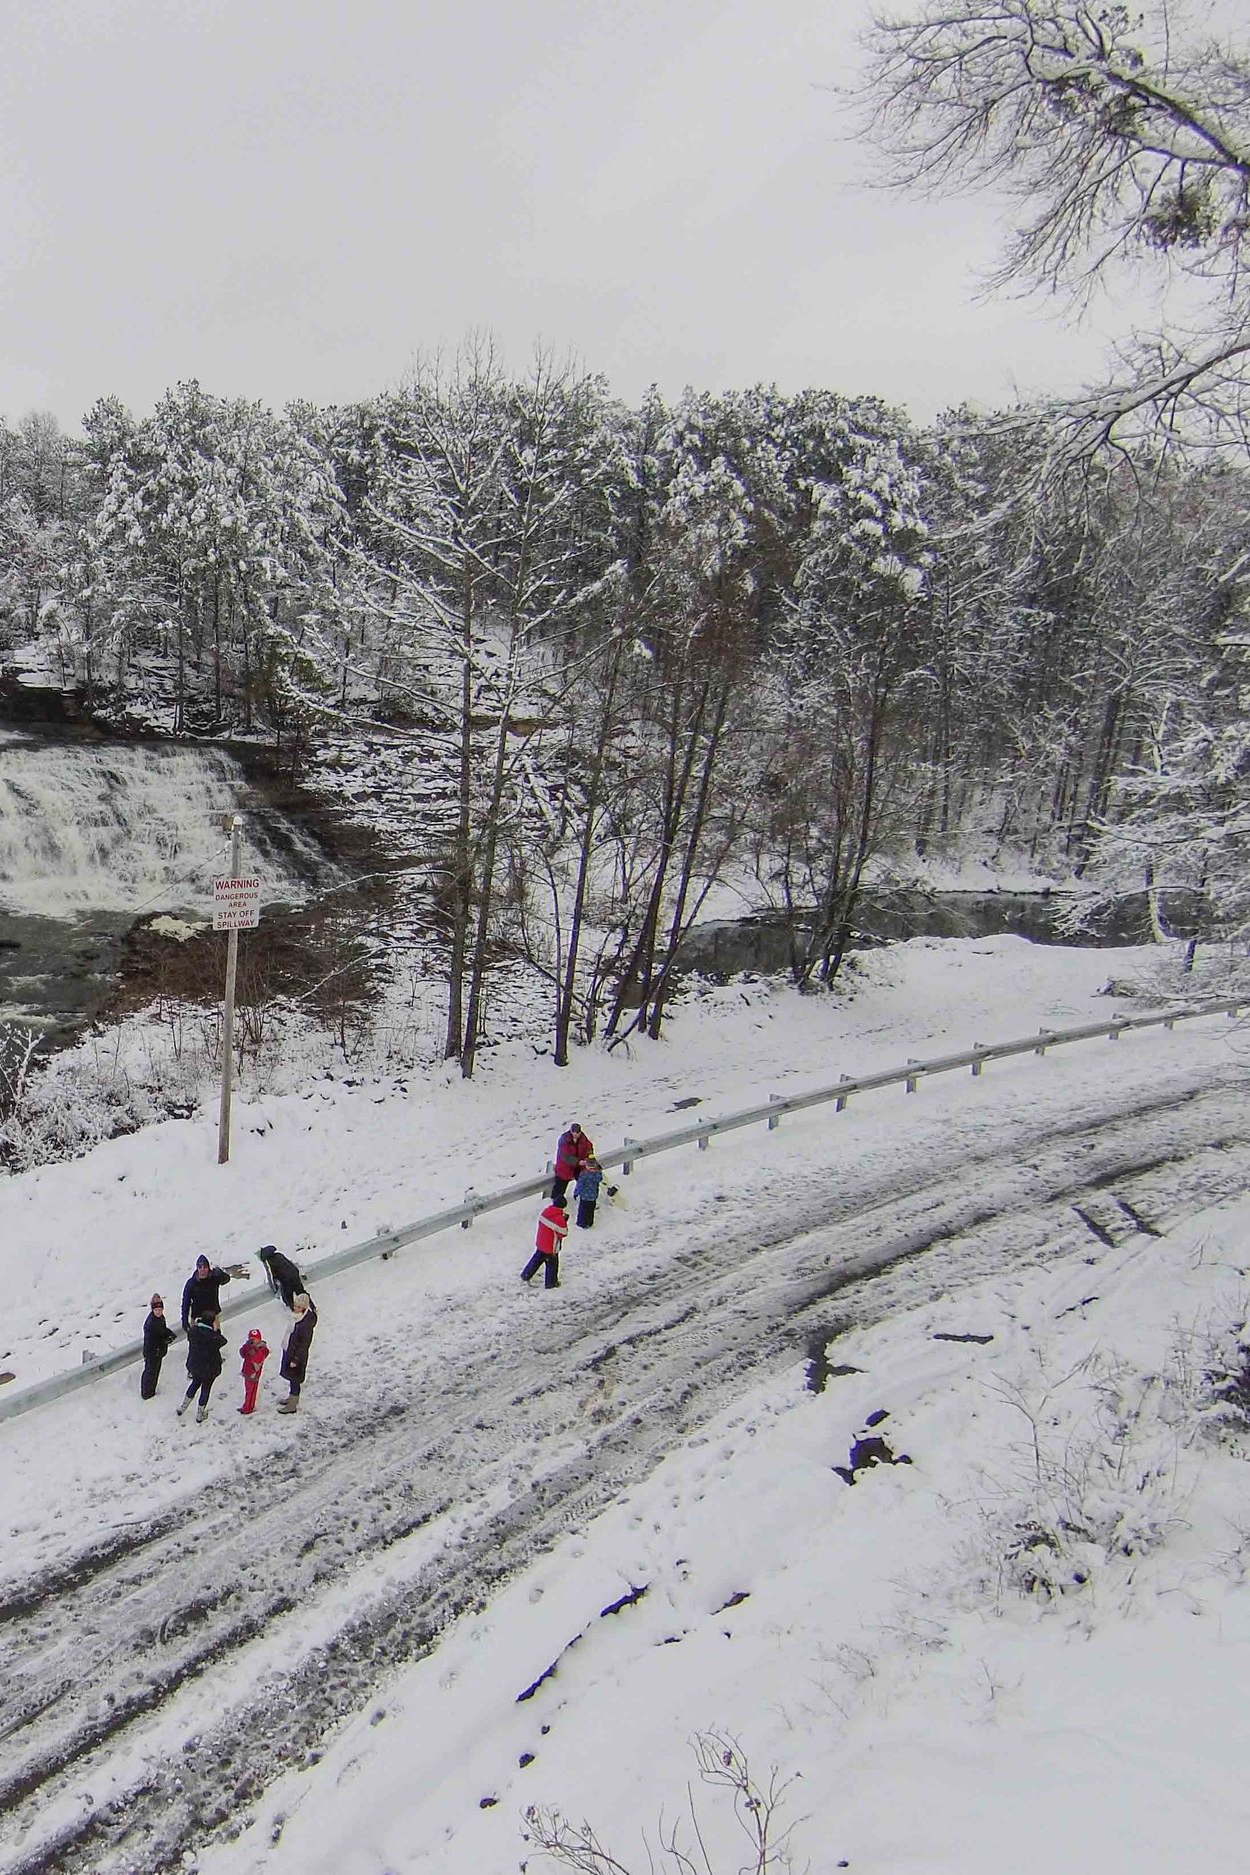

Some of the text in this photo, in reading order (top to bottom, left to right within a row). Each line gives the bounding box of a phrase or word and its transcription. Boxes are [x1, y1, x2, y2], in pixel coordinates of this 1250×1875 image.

[215, 879, 259, 890] WARNING
[215, 892, 258, 901] DANGEROUS
[217, 911, 237, 919] STAY
[217, 920, 254, 928] SPILLWAY
